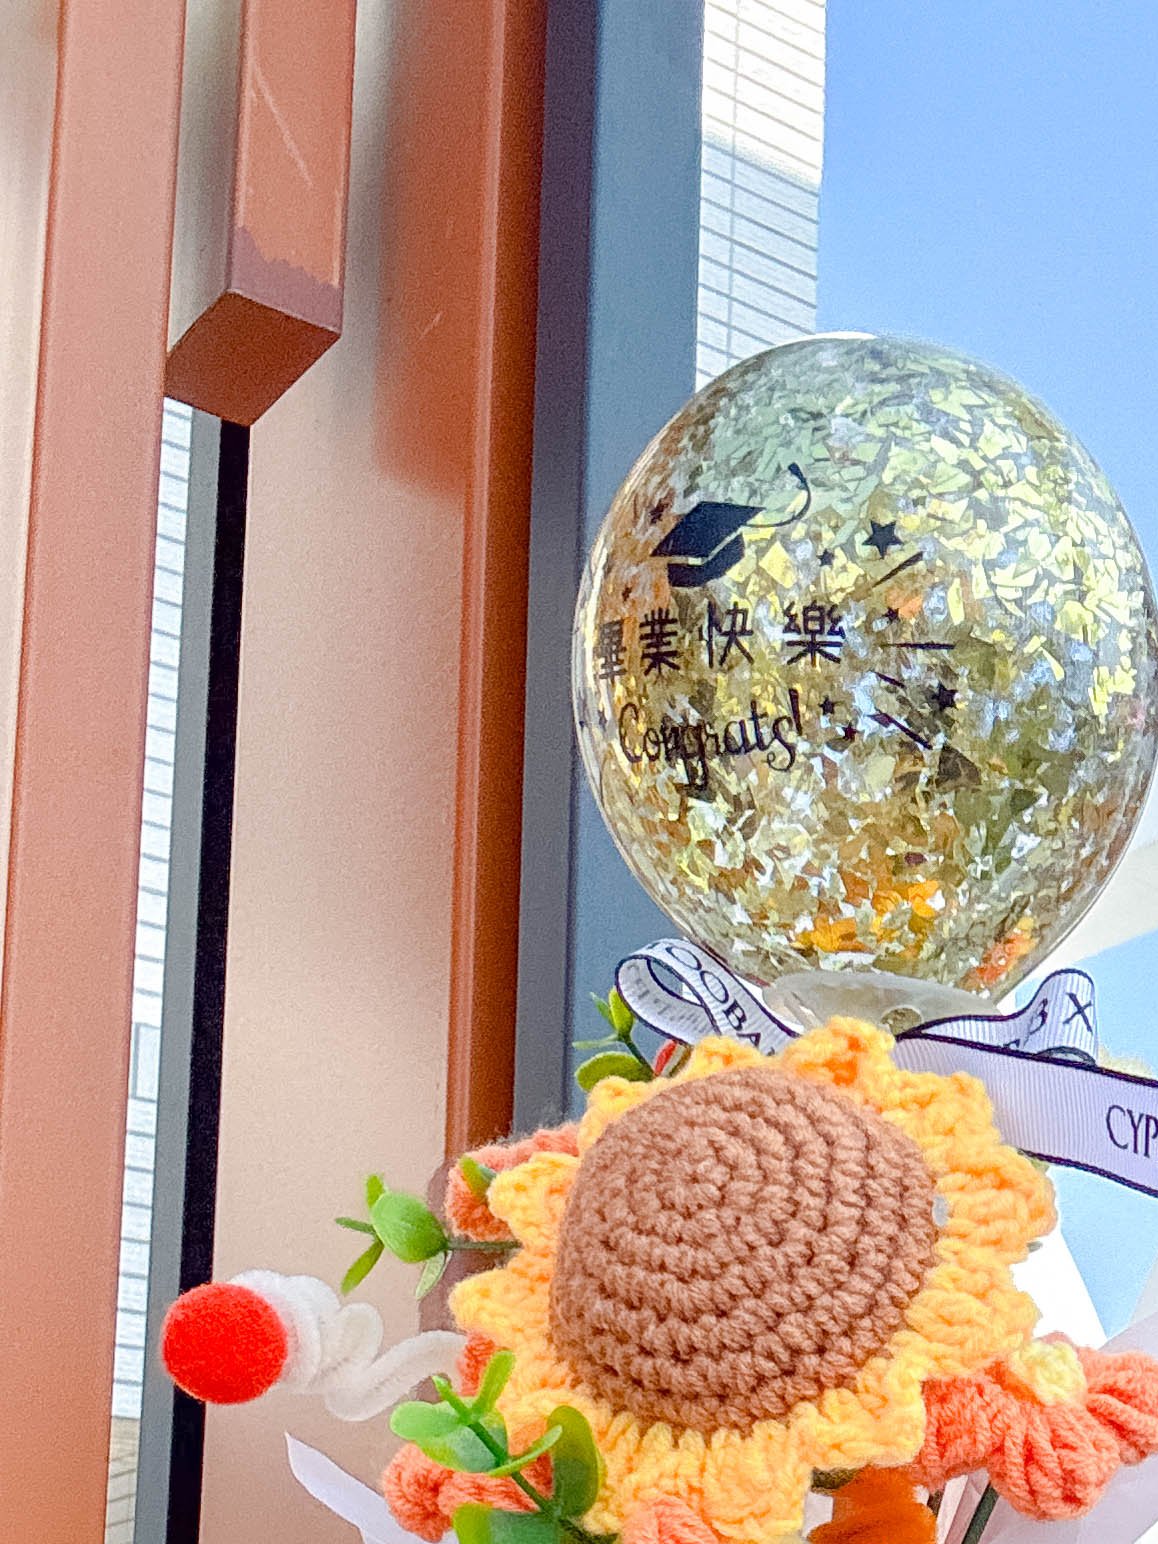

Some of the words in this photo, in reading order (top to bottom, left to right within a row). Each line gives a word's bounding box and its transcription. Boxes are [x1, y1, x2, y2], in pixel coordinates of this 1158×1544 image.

[593, 600, 846, 681] 畢業快樂
[618, 688, 803, 791] Congrats!
[648, 942, 777, 1056] OOBA
[1062, 992, 1095, 1034] X
